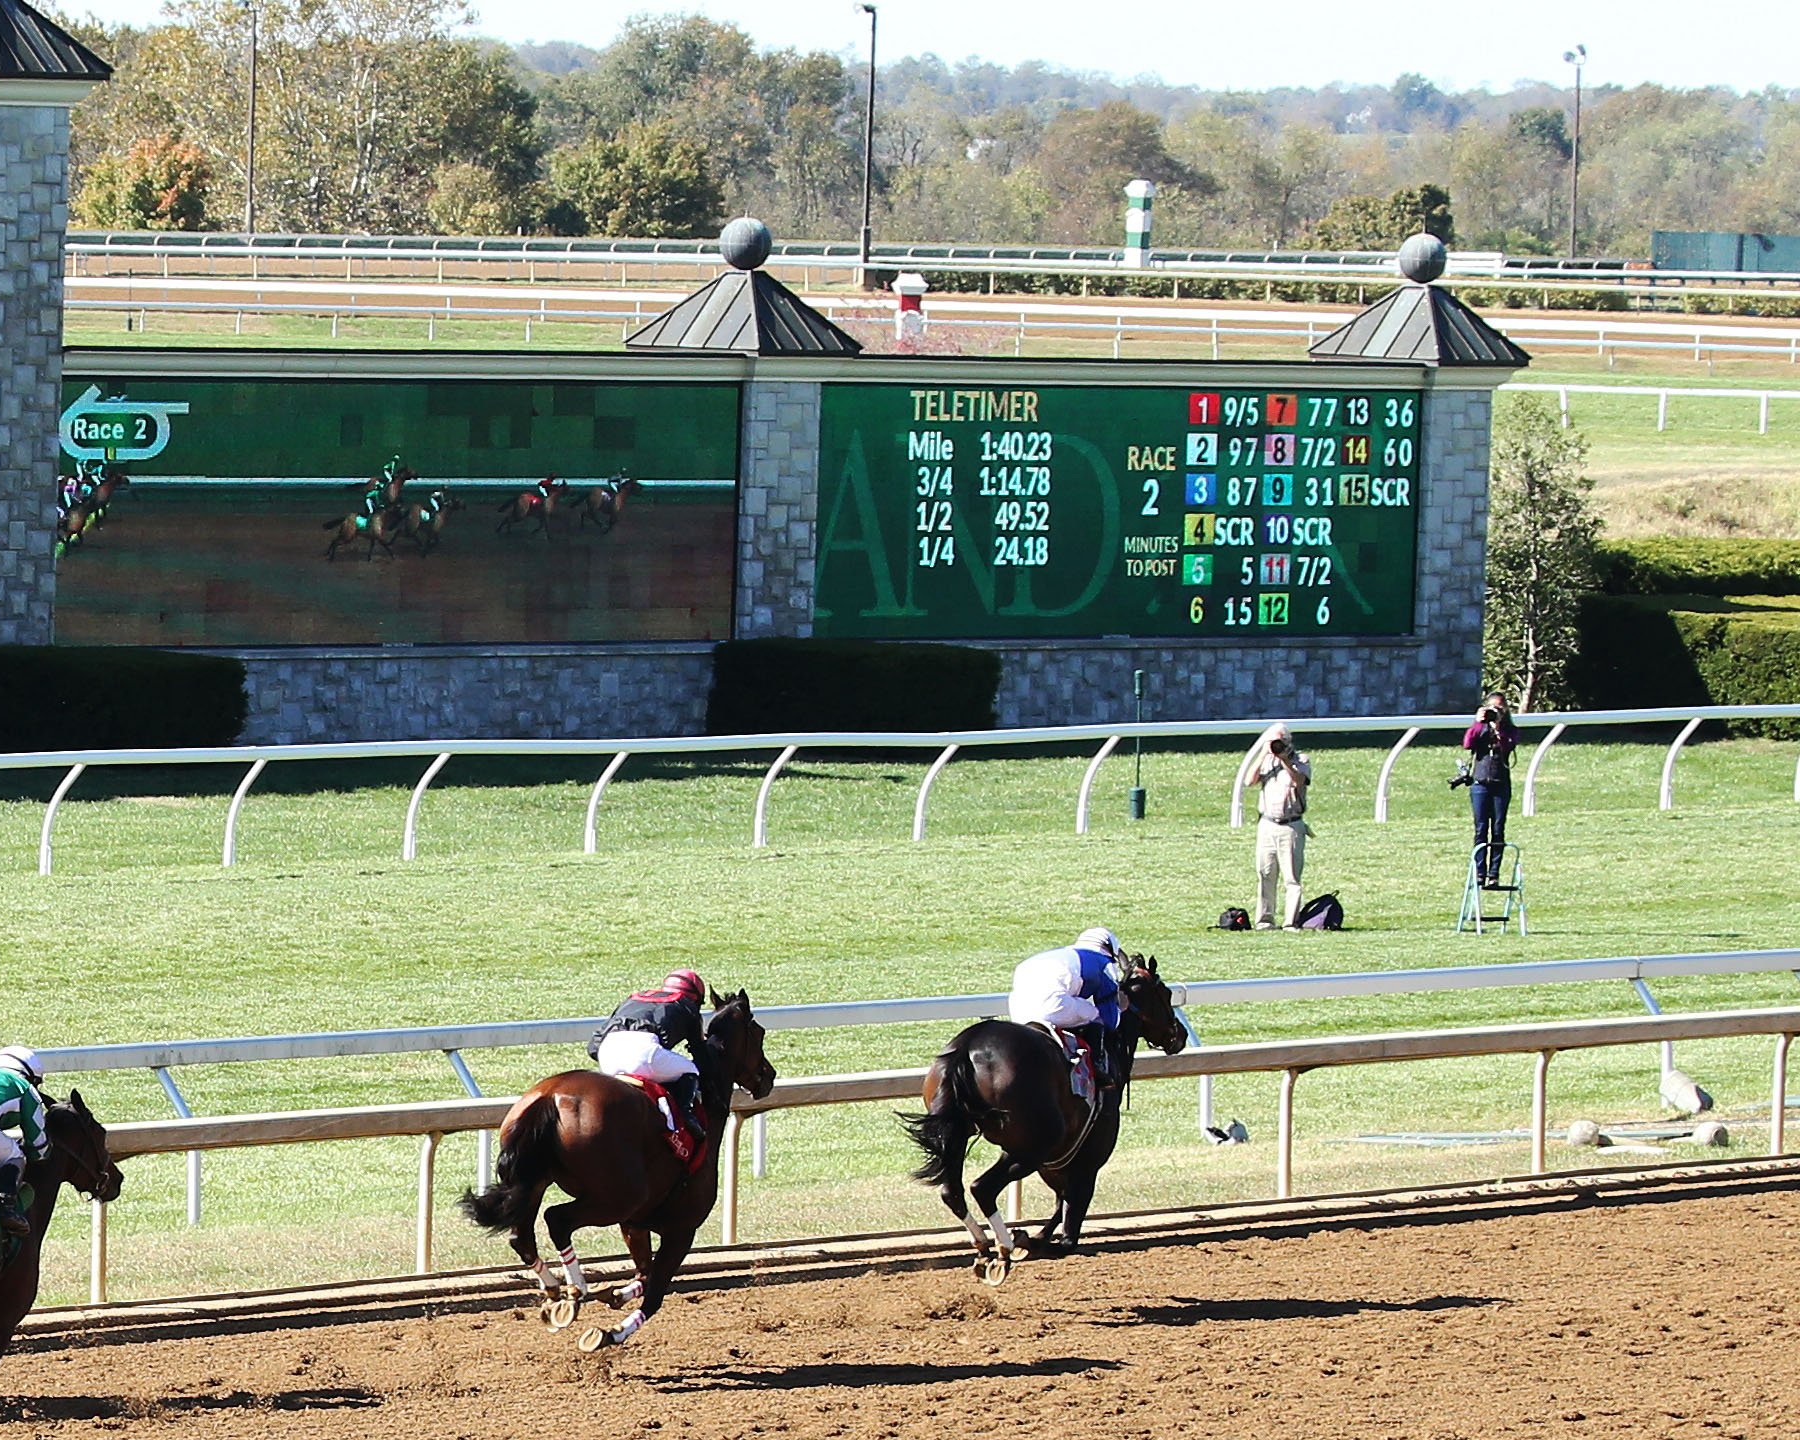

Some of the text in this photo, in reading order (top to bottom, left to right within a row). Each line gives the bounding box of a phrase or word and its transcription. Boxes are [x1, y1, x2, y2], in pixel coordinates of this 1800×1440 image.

[910, 390, 1040, 423] TELETIMER
[1198, 396, 1414, 427] 1 9/5 7 77 13 36
[73, 418, 147, 440] Race 2
[908, 431, 1052, 462] Mile 1:40.23
[1127, 446, 1177, 471] RACE
[1196, 437, 1413, 468] 2 97 8 7/2 14 60
[916, 466, 1051, 497] 3/4 1:14.78
[1141, 478, 1160, 516] 2
[1194, 477, 1410, 507] 3 87 9 31 15 SCR
[916, 501, 1050, 533] 1/2 49.52
[1193, 516, 1332, 546] 4 SCR 10 SCR
[919, 536, 1049, 568] 1/4 24.18
[1124, 536, 1179, 554] MINUTES
[1126, 559, 1177, 577] TO POST
[1192, 556, 1331, 587] 5 5 11 7/2
[1190, 597, 1330, 625] 6 15 12 6
